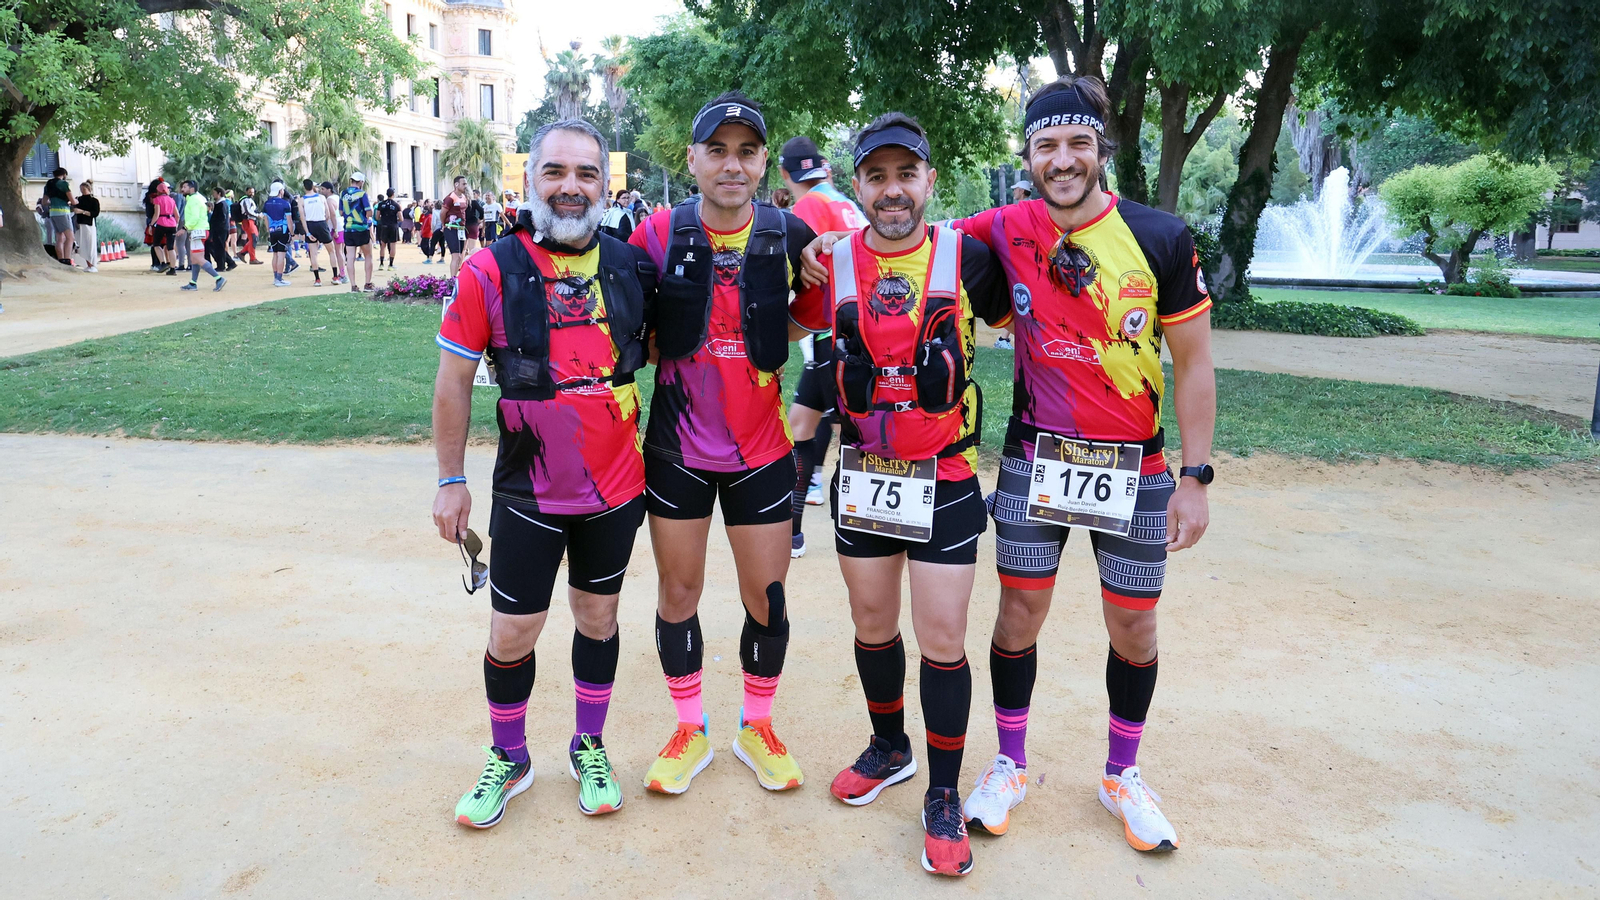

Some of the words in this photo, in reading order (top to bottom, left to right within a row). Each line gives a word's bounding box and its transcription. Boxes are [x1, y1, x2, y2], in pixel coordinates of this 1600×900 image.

[867, 453, 911, 474] Sherry
[1064, 443, 1113, 465] Sherry
[870, 478, 902, 510] 75
[1060, 468, 1112, 502] 176
[865, 513, 886, 521] GALINDO
[866, 507, 895, 516] FRANCISCO
